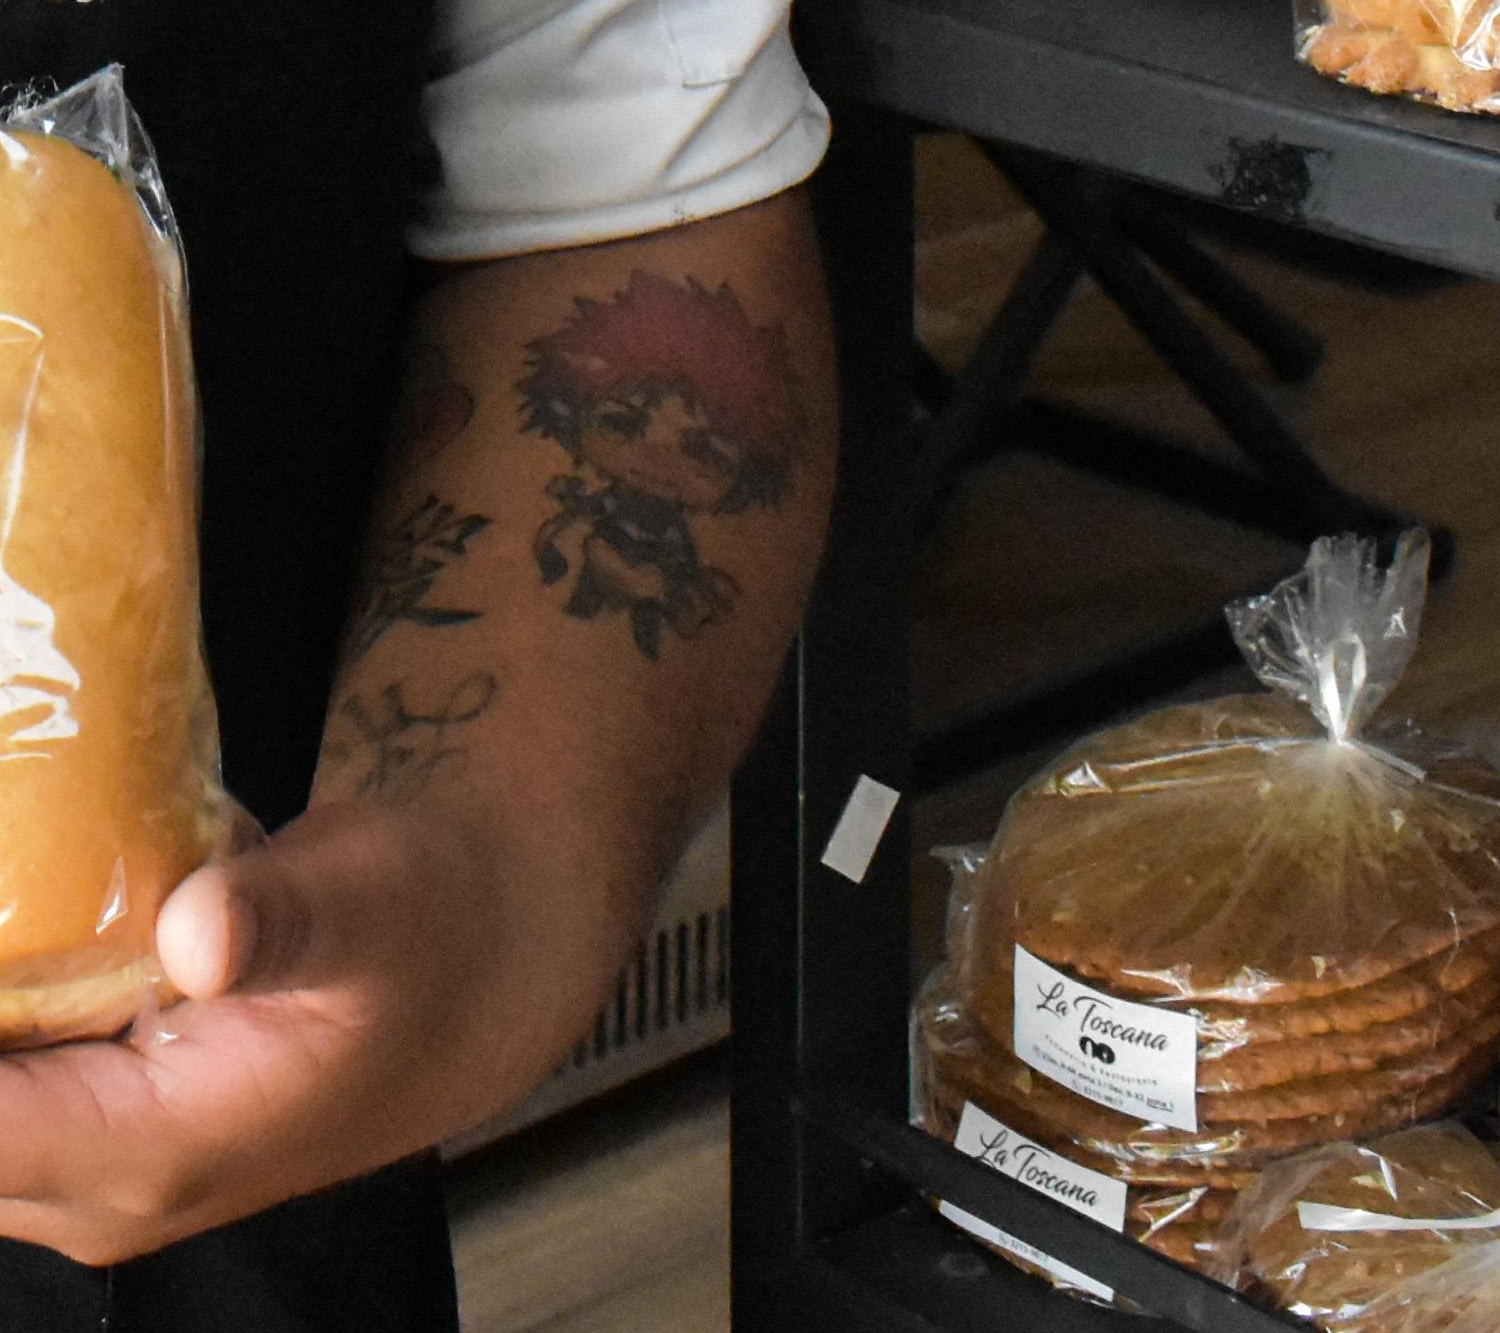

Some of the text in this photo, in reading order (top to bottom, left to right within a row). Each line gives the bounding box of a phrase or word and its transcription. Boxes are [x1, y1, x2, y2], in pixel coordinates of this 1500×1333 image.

[1036, 981, 1169, 1051] La Toscana
[977, 1129, 1098, 1207] La Toscana
